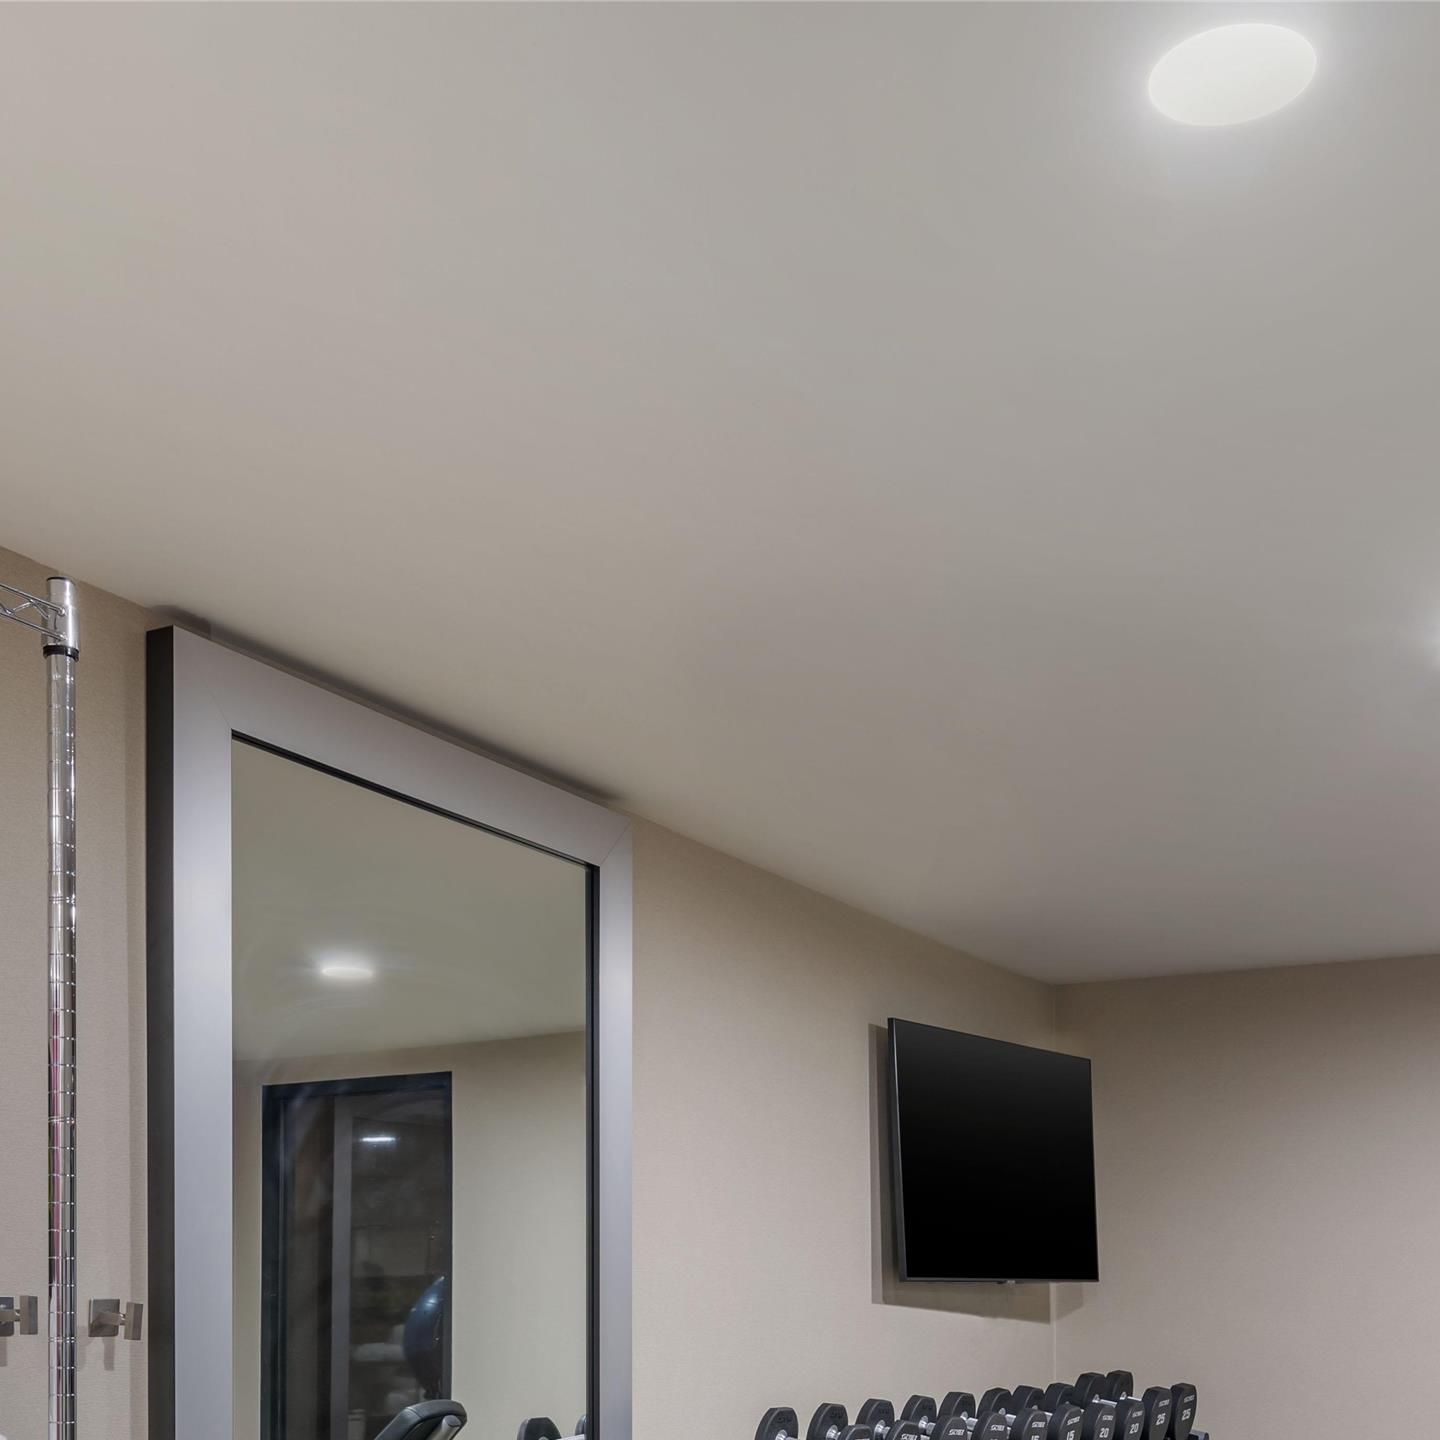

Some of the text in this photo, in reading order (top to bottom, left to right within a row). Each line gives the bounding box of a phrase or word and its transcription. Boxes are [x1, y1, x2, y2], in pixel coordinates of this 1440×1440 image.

[1155, 1413, 1166, 1426] 25
[1181, 1408, 1191, 1421] 25
[1100, 1427, 1110, 1438] 20
[1129, 1423, 1140, 1434] 20
